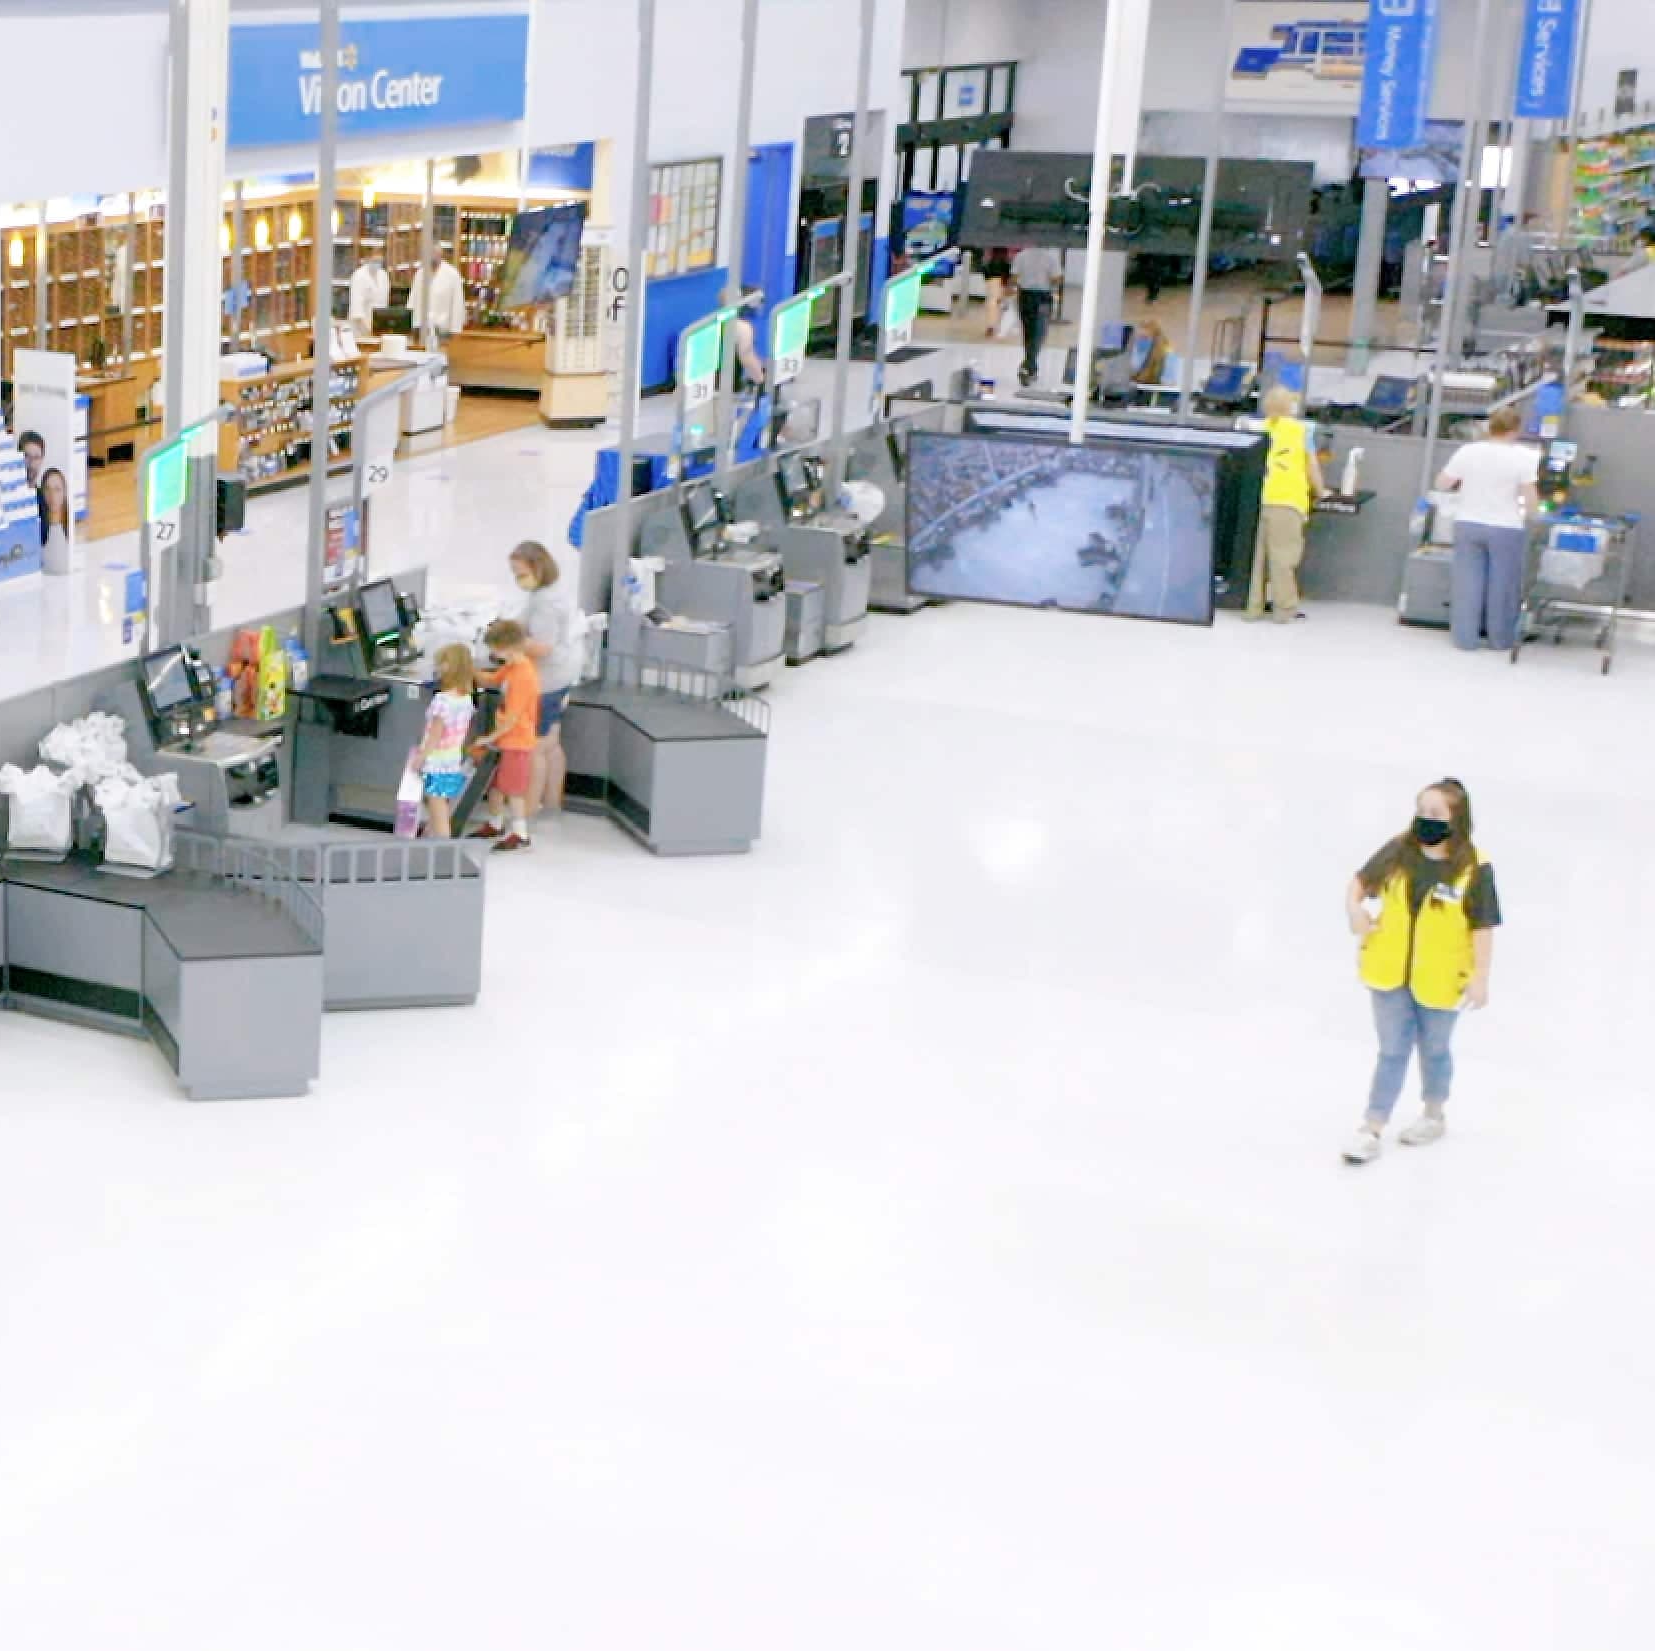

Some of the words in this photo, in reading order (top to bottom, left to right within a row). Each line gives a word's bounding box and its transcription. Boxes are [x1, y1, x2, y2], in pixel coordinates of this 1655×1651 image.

[299, 73, 367, 116] Viion
[370, 69, 444, 111] Center
[368, 464, 389, 484] 29
[155, 521, 177, 541] 27
